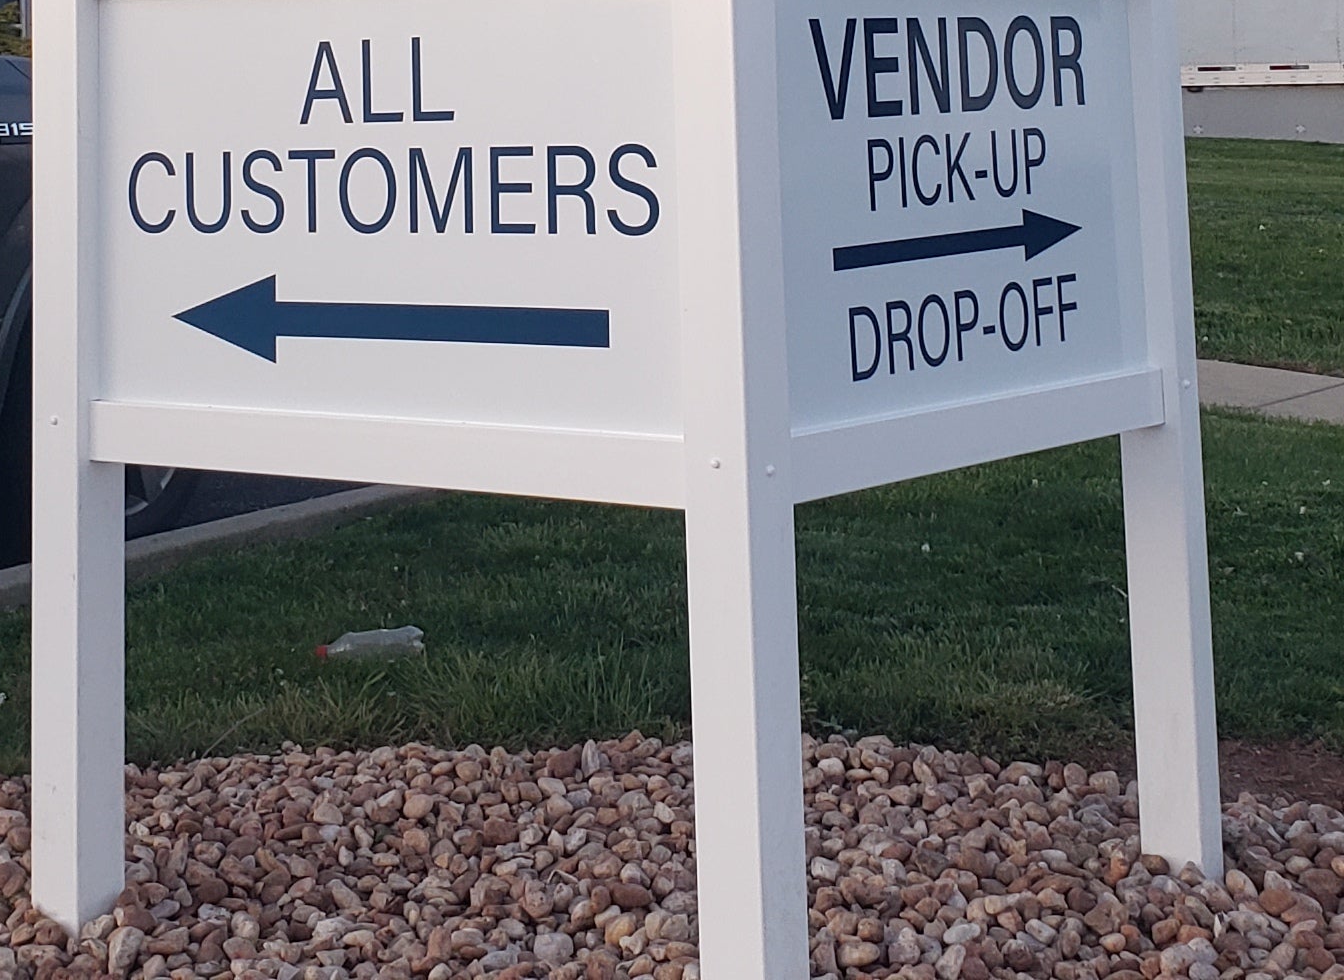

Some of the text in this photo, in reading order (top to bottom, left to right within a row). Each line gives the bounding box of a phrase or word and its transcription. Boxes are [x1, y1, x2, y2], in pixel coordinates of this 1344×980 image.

[299, 36, 455, 125] ALL
[808, 14, 1086, 120] VENDOR
[128, 143, 660, 236] CUSTOMERS
[866, 127, 1047, 211] PICK-UP
[848, 273, 1078, 382] DROP-OFF
